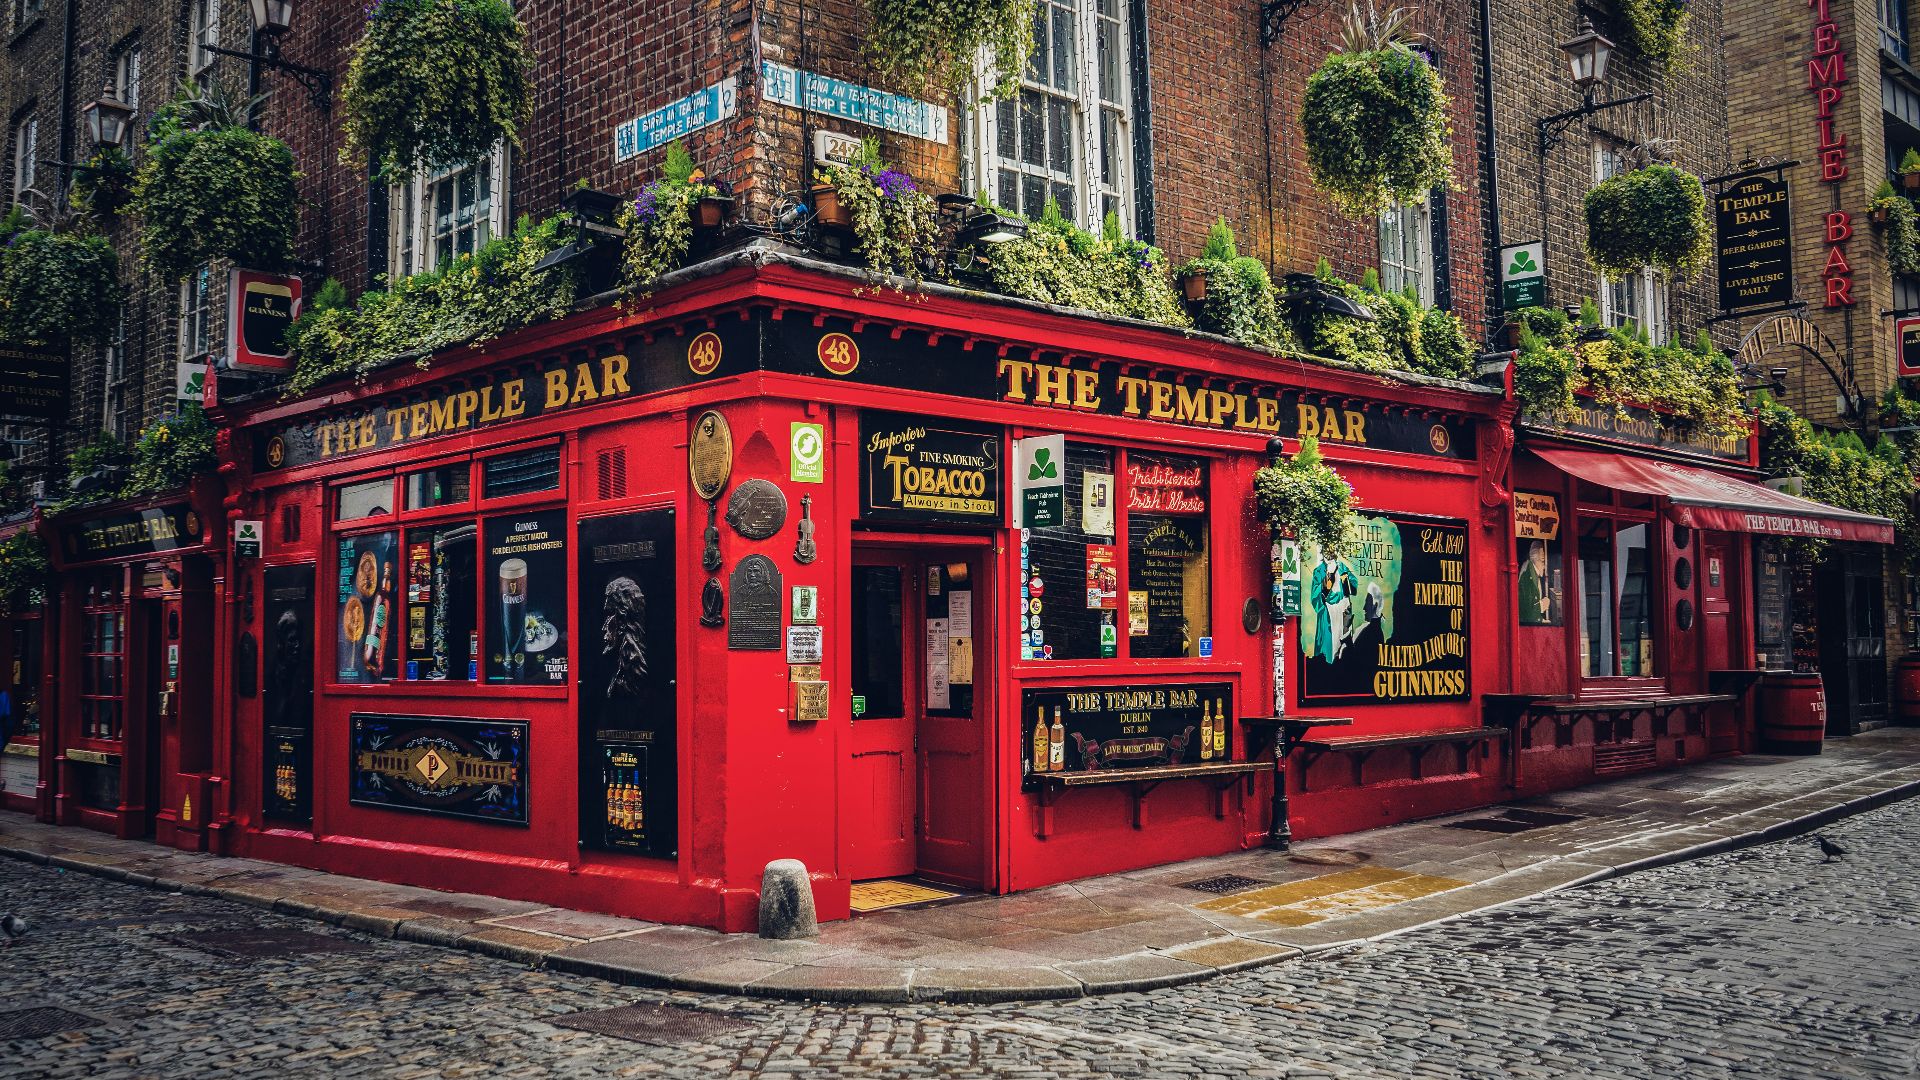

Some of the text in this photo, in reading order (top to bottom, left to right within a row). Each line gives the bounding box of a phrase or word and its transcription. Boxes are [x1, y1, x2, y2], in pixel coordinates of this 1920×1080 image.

[832, 84, 846, 98] AN
[805, 93, 847, 115] TEMPLE
[884, 113, 922, 133] SOUTH
[650, 120, 683, 143] TEMPLE
[1741, 182, 1763, 194] THE
[1720, 190, 1786, 212] TEMPLE
[1735, 209, 1772, 225] BAR
[1722, 239, 1785, 256] BEER GARDEN
[1823, 211, 1861, 308] BAR
[1726, 272, 1784, 289] LIVE MUSIC
[1739, 285, 1771, 297] DAILY
[249, 306, 287, 318] GUINNESS
[693, 341, 715, 366] 48
[825, 339, 850, 363] 48
[317, 354, 630, 457] THE TEMPLE BAR
[999, 359, 1366, 444] THE TEMPLE BAR
[868, 426, 926, 458] Importers
[905, 443, 915, 453] OF
[1433, 429, 1445, 448] 48
[269, 442, 281, 462] 48
[920, 451, 985, 470] FINE SMOKING
[884, 455, 985, 502] TOBACCO
[1128, 466, 1201, 486] Traditional
[906, 495, 994, 512] Always in Stock
[1127, 487, 1204, 512] Irish Music
[1515, 496, 1528, 508] Beer
[1530, 498, 1550, 513] Garden
[515, 521, 538, 532] GUINNESS
[1515, 509, 1540, 525] Smoking
[1745, 514, 1766, 529] THE
[1766, 516, 1802, 534] TEMPLE
[1803, 520, 1821, 535] BAR
[150, 515, 180, 540] BAR
[1144, 525, 1194, 549] TEMPLE BAR
[1359, 524, 1382, 542] THE
[1520, 524, 1534, 537] Area
[505, 531, 548, 544] A PERFECT MATCH
[1445, 534, 1463, 554] 1840
[492, 540, 563, 556] FOR DELICIOUS IRISH OYSTERS
[1142, 548, 1170, 556] Traditional
[1348, 541, 1394, 561] TEMPLE
[1359, 560, 1383, 578] BAR
[1440, 560, 1463, 583] THE
[503, 593, 524, 605] GUINNESS
[1414, 583, 1464, 607] EMPEROR
[1450, 609, 1464, 631] OF
[1377, 632, 1466, 668] MALTED LIQUORS
[544, 664, 568, 672] TEMPLE
[550, 671, 562, 679] BAR
[1373, 670, 1465, 698] GUINNESS
[1067, 689, 1199, 712] THE TEMPLE BAR
[1120, 712, 1151, 723] DUBLIN
[1123, 726, 1136, 734] EST.
[1105, 742, 1165, 757] LIVE MUSIC DAILY
[371, 754, 506, 781] POWERS P WHISKEY
